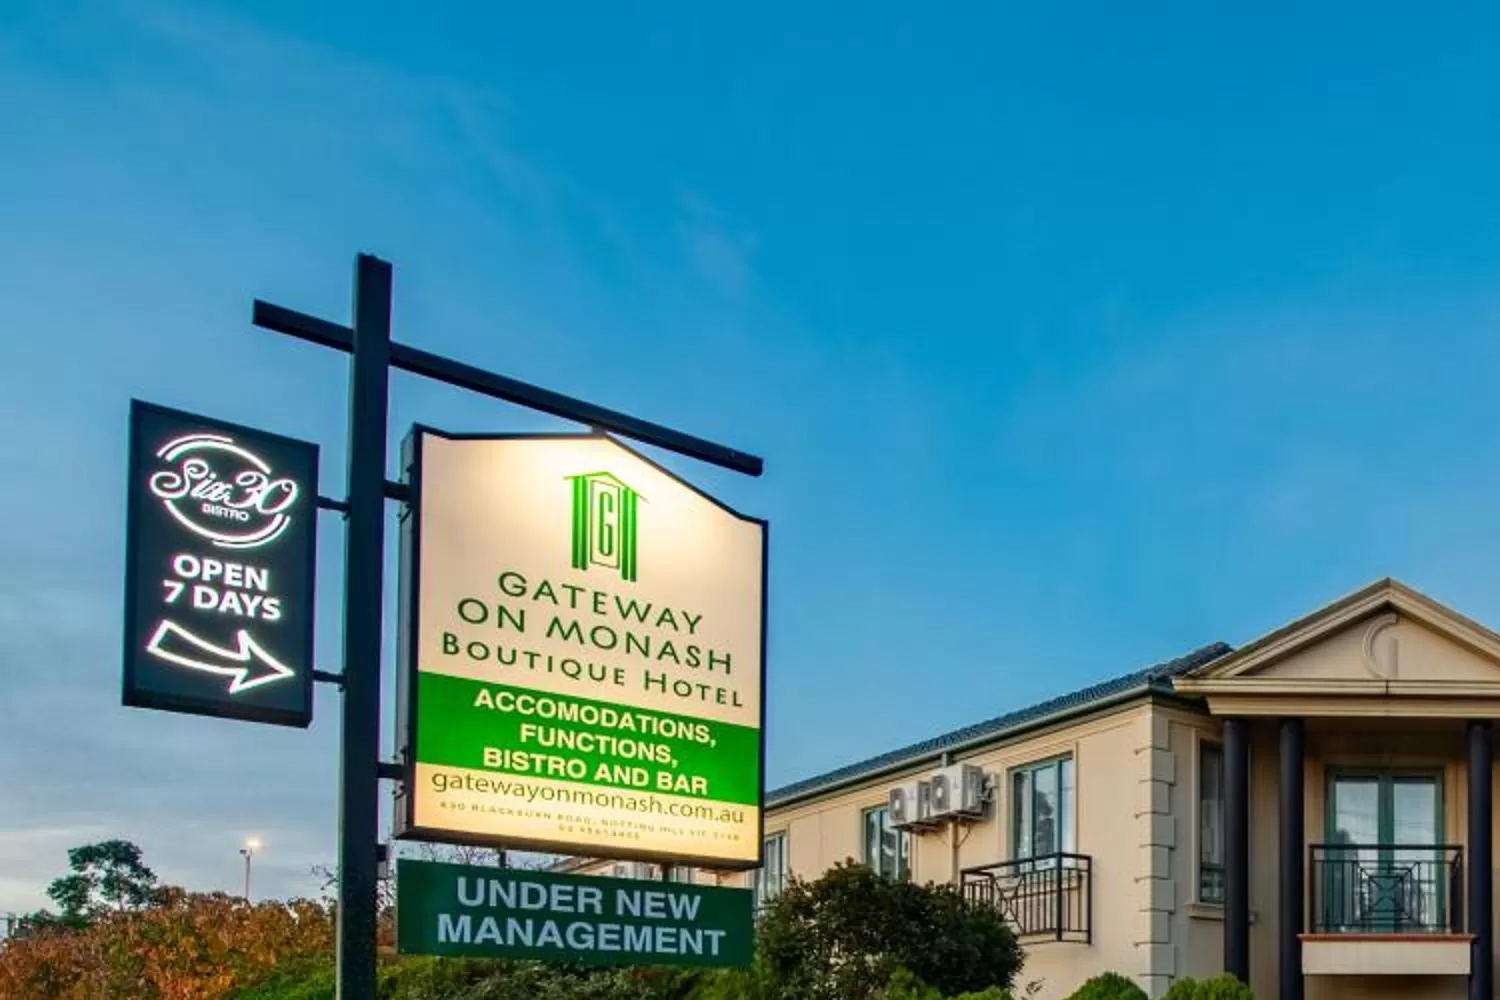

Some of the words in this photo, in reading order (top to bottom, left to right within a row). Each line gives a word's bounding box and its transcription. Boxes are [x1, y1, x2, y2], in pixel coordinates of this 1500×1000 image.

[173, 554, 269, 591] OPEN
[163, 580, 184, 603] 7
[193, 586, 281, 621] DAYS
[498, 571, 702, 634] GATEWAY
[457, 598, 525, 633] ON
[546, 616, 731, 675] MONASH
[442, 632, 625, 686] BOUTIQUE
[645, 669, 743, 708] HOTEL
[473, 688, 717, 748] ACCOMODATIONS,
[520, 723, 679, 768] FUNCTIONS,
[483, 747, 587, 779] BISTRO
[594, 765, 649, 788] AND
[657, 771, 708, 796] BAR
[431, 771, 744, 824] gatewayonmonash.com.au
[456, 876, 603, 914] UNDER
[615, 889, 701, 921] NEW
[437, 913, 726, 956] MANAGEMENT
